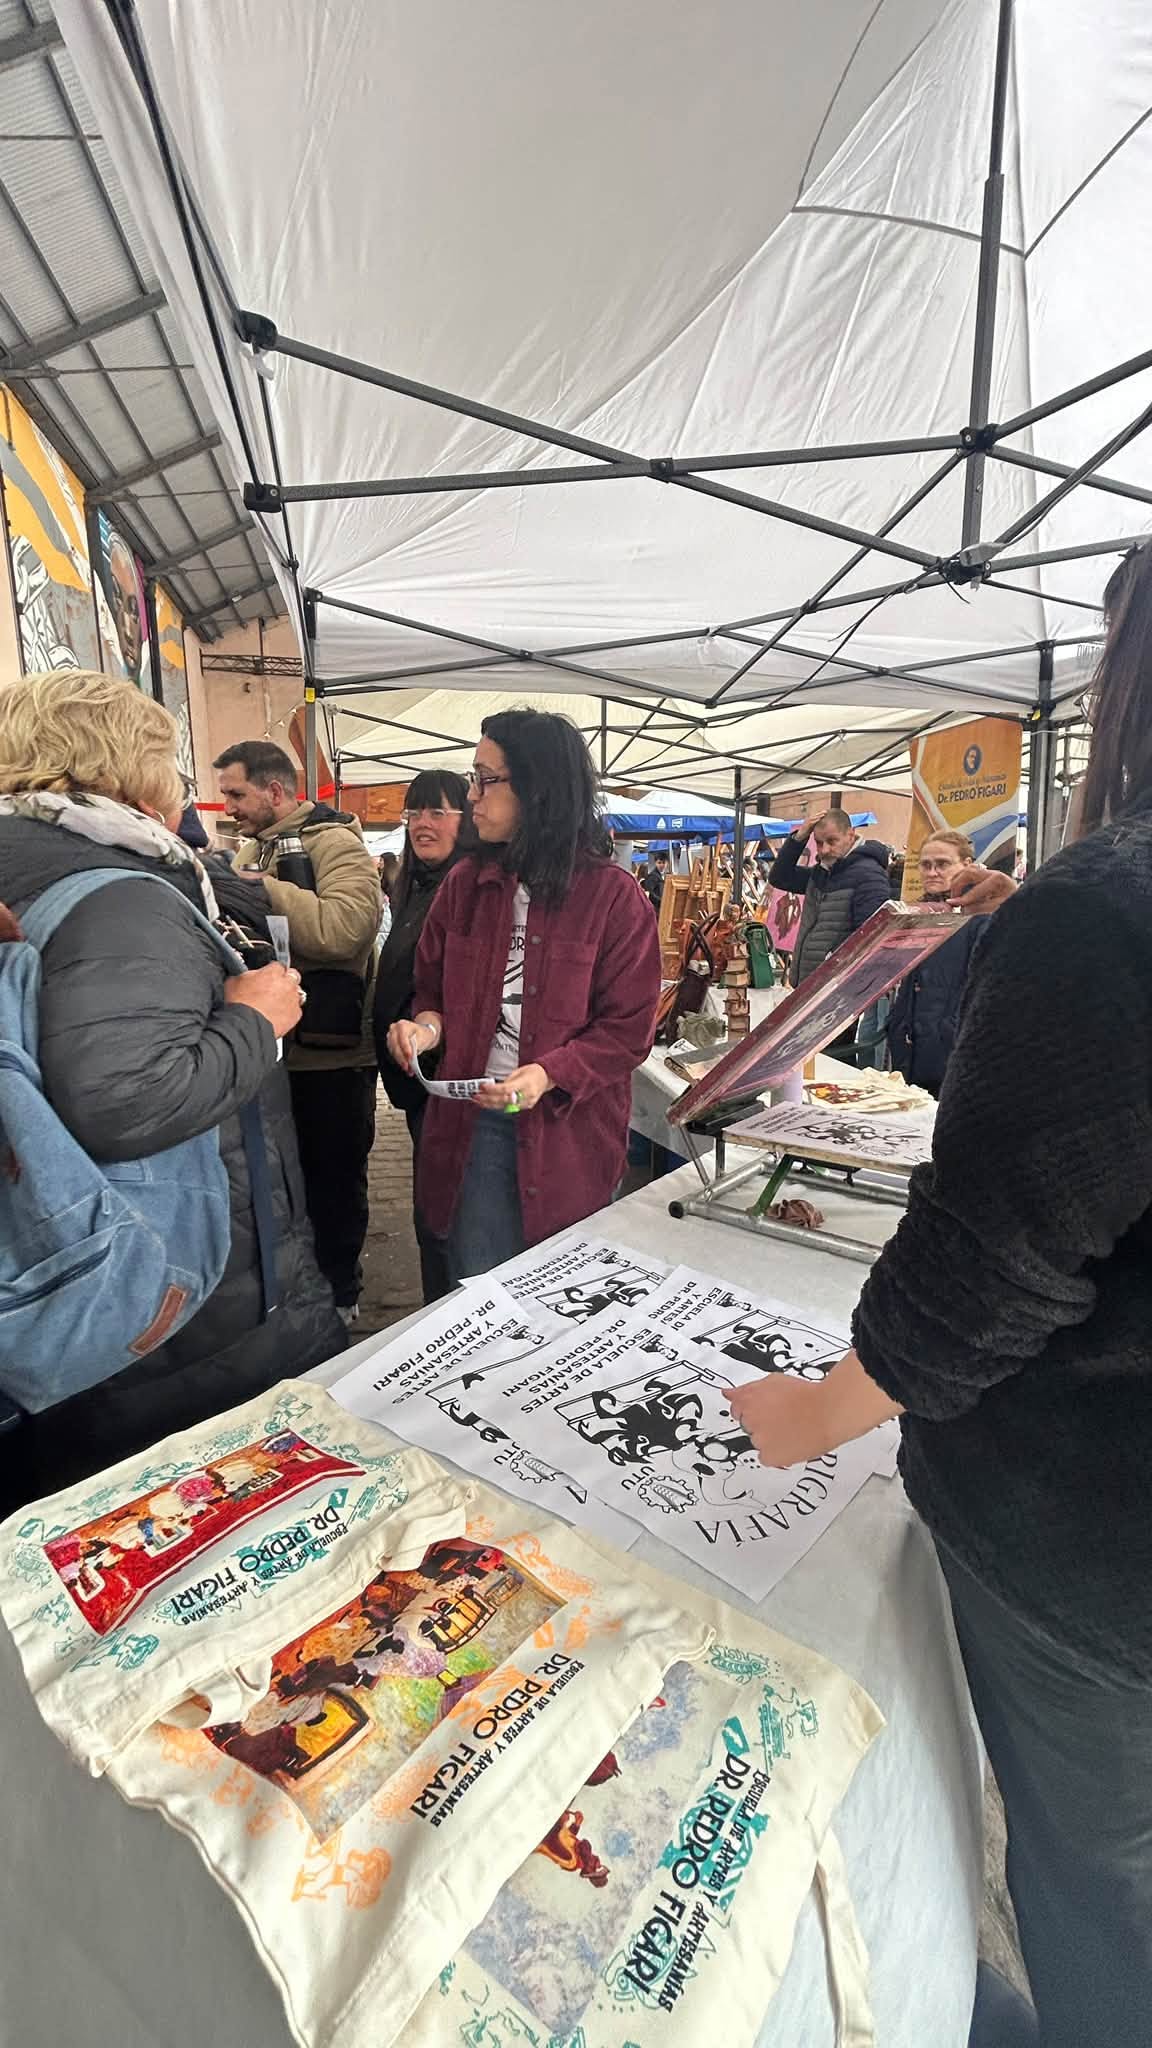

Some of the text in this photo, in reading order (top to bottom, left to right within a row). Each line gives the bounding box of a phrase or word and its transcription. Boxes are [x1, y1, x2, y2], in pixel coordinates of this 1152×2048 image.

[950, 787, 976, 802] PEDRO
[977, 783, 1006, 799] FIGARI
[512, 1247, 609, 1300] ESCUELA DE ARTES
[533, 1254, 570, 1274] PEDRO
[648, 1295, 682, 1320] PEDRO
[681, 1287, 722, 1321] ESCUELA
[484, 1320, 495, 1330] Y
[372, 1299, 496, 1391] DR. PEDRO FIGARI
[392, 1318, 519, 1405] ESCUELA DE ARTES
[502, 1319, 627, 1397] DR. PEDRO FIGARI
[520, 1328, 652, 1414] ESCUELA DE ARTES
[528, 1333, 627, 1394] Y ARTESANÍAS
[621, 1466, 655, 1491] UTU
[693, 1453, 838, 1547] RIGRAFÍA
[294, 1547, 308, 1561] DE
[308, 1522, 349, 1554] ESCUELA
[170, 1505, 341, 1615] DR. PEDRO FIGARI
[260, 1555, 295, 1580] ARTES
[251, 1576, 262, 1587] Y
[546, 1660, 585, 1698] ESCUELA
[534, 1697, 550, 1712] DE
[409, 1652, 573, 1820] DR. PEDRO FIGARI
[502, 1707, 536, 1745] ARTES
[494, 1741, 506, 1754] Y
[740, 1767, 770, 1822] ESCUELA
[729, 1818, 748, 1842] DE
[623, 1752, 751, 1995] DR. PEDRO FIGARI
[708, 1838, 738, 1892] ARTES
[703, 1890, 719, 1908] Y
